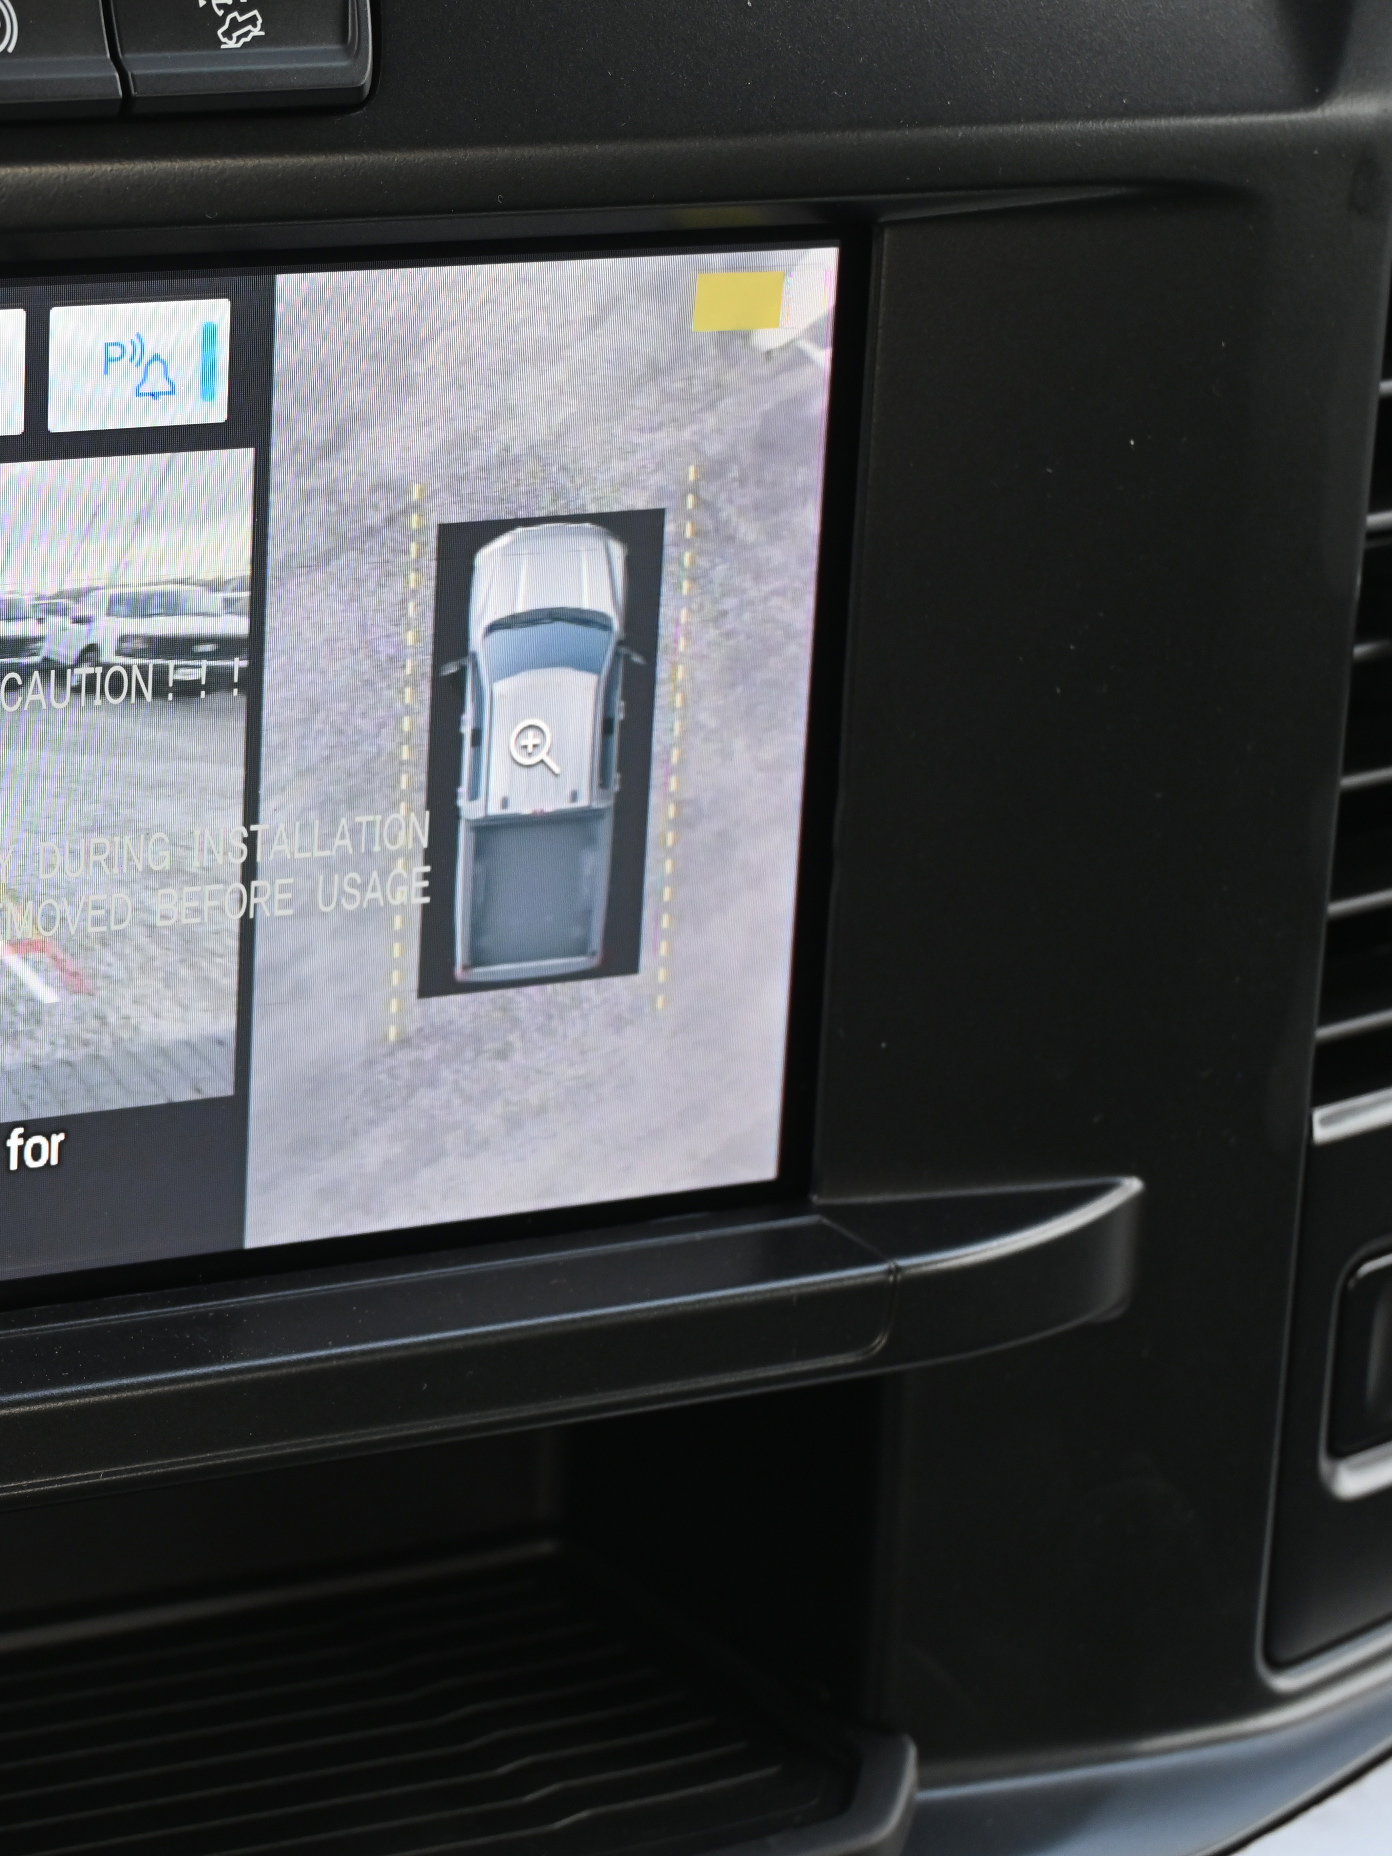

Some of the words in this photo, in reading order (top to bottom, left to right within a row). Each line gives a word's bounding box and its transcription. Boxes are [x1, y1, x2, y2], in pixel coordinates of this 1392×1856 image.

[39, 831, 170, 880] DURING
[192, 811, 430, 867] INSTALLATION
[155, 879, 295, 927] BEFORE
[317, 865, 431, 912] USAGE
[6, 1127, 65, 1170] for
